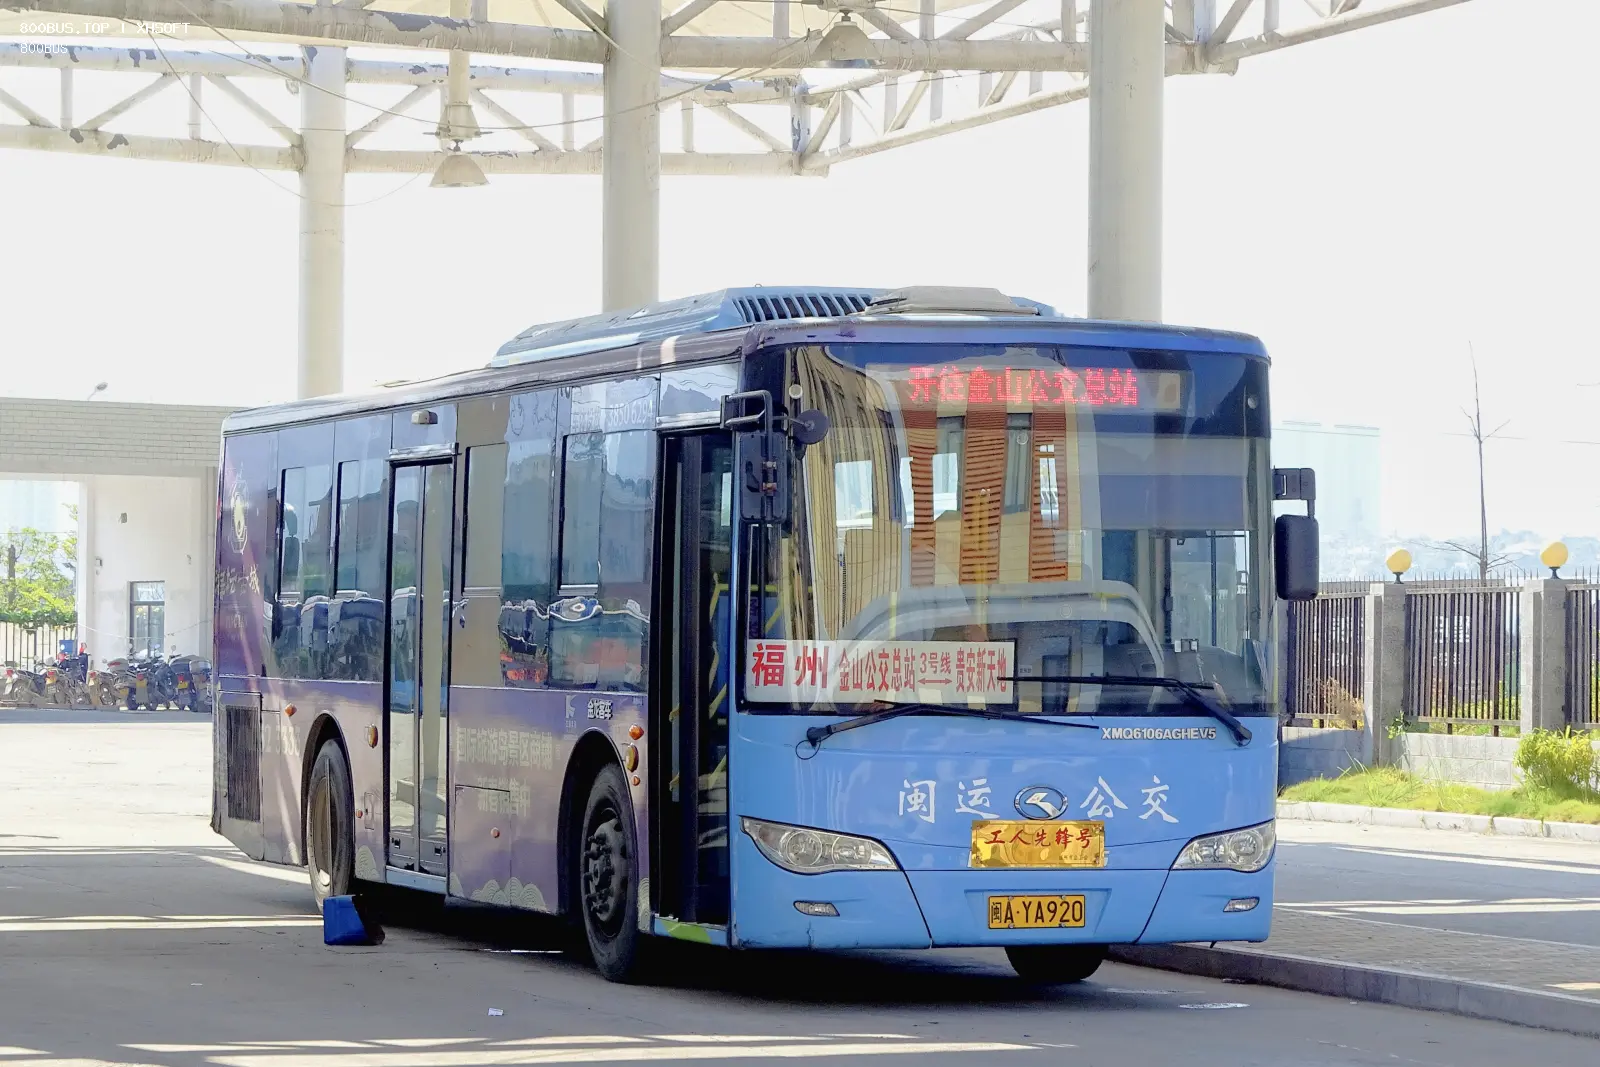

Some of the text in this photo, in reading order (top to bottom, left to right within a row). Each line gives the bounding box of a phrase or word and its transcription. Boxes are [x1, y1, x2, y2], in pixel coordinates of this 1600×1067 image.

[908, 365, 1138, 406] 开往金山公交总站
[752, 643, 1008, 693] 福州 金山公交总站 3号线 贵安新天地
[1101, 726, 1217, 741] XMQ6106AGHEV5
[898, 775, 1179, 824] 闽运 公交
[984, 827, 1095, 850] 工人先锋号
